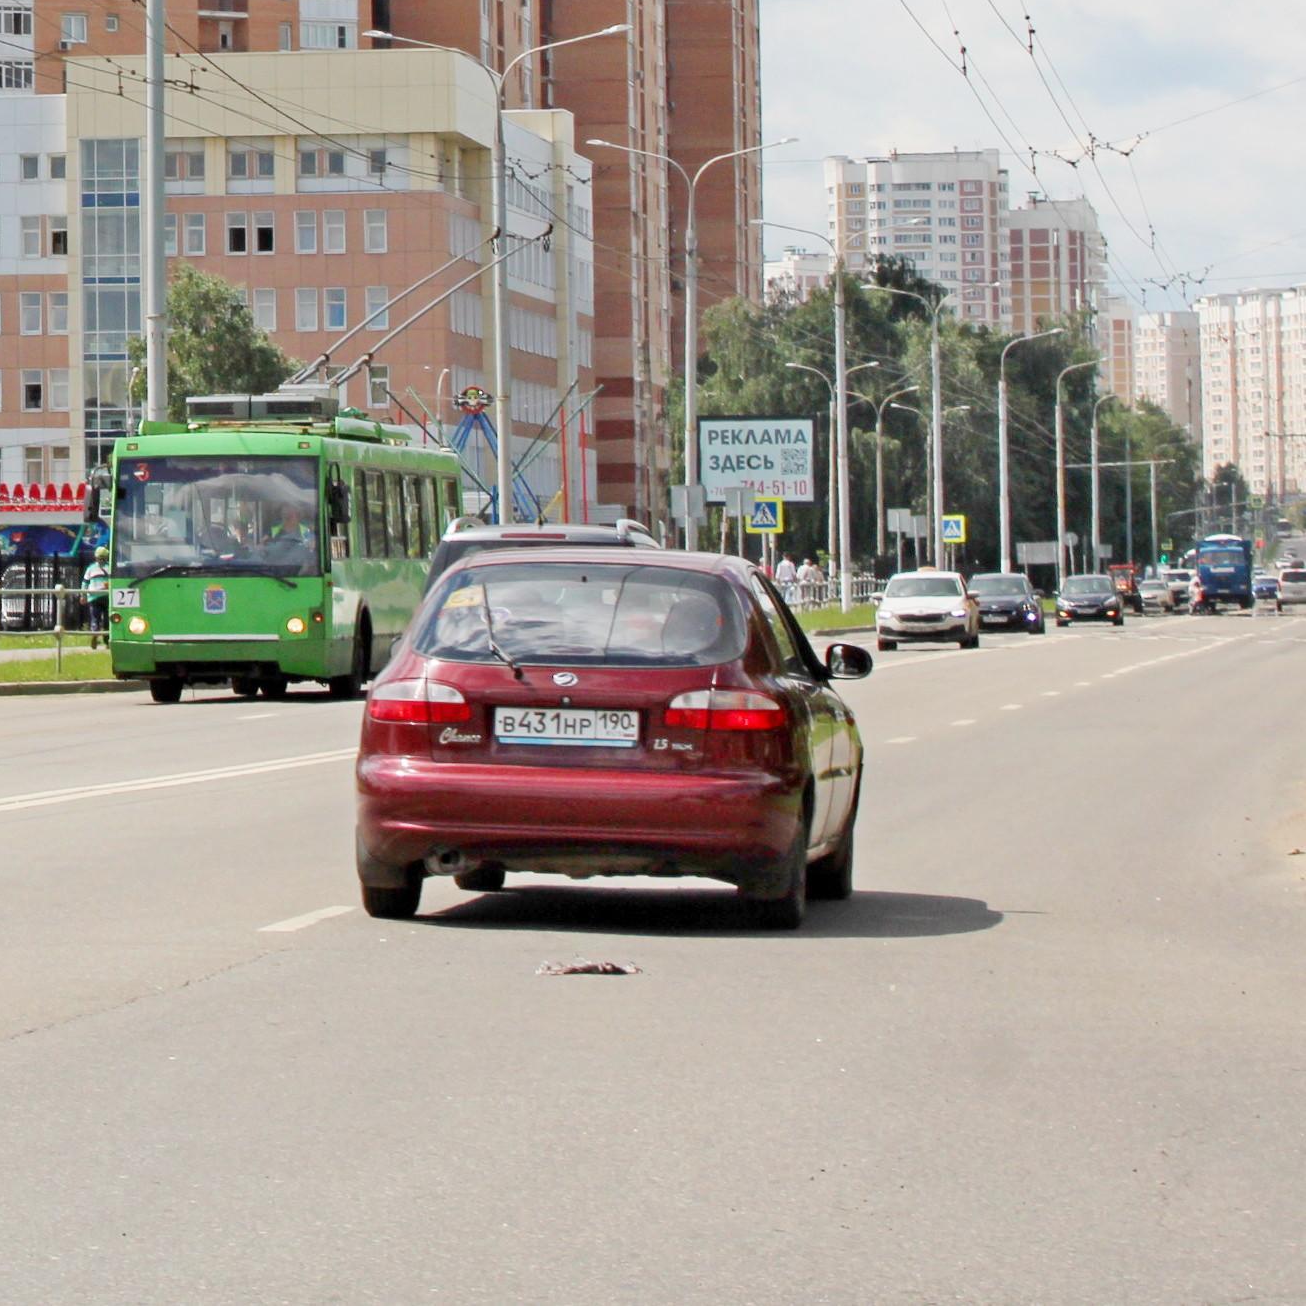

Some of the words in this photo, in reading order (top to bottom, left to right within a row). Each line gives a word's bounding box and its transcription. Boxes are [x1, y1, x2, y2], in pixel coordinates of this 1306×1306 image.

[708, 429, 808, 445] РЕКЛАМА
[709, 454, 774, 473] ЗДЕСЬ
[117, 590, 136, 606] 27
[502, 710, 592, 736] В431НР
[598, 712, 631, 731] 190
